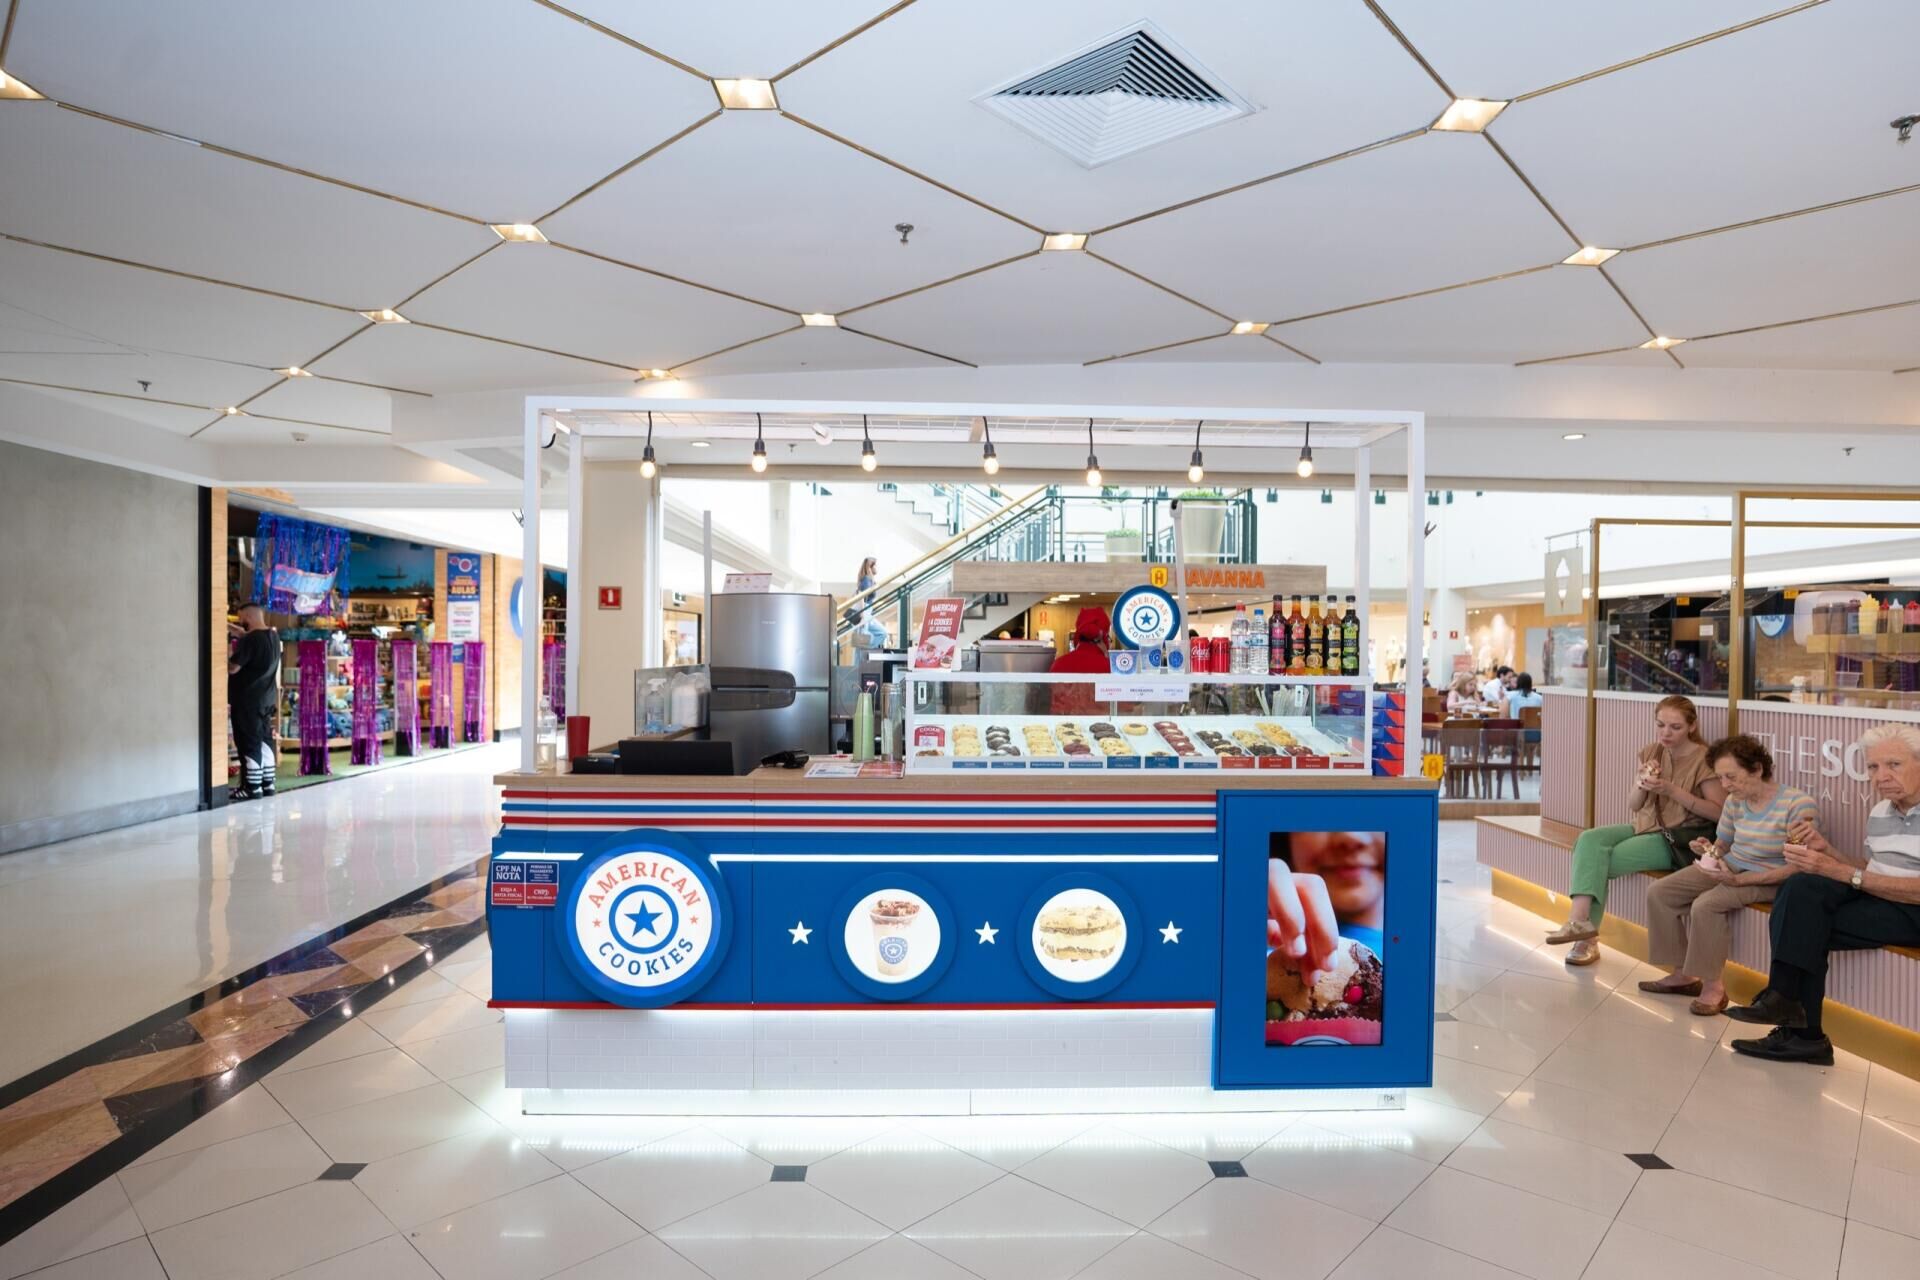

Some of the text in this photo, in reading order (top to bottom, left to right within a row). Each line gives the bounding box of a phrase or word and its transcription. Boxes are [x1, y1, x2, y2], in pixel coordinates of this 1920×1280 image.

[1176, 568, 1265, 588] AVANNA
[1126, 595, 1169, 616] AMERICAN
[496, 872, 520, 880] NOTA
[510, 865, 521, 873] NA
[588, 861, 701, 909] AMERICAN
[598, 937, 694, 976] COOKIES
